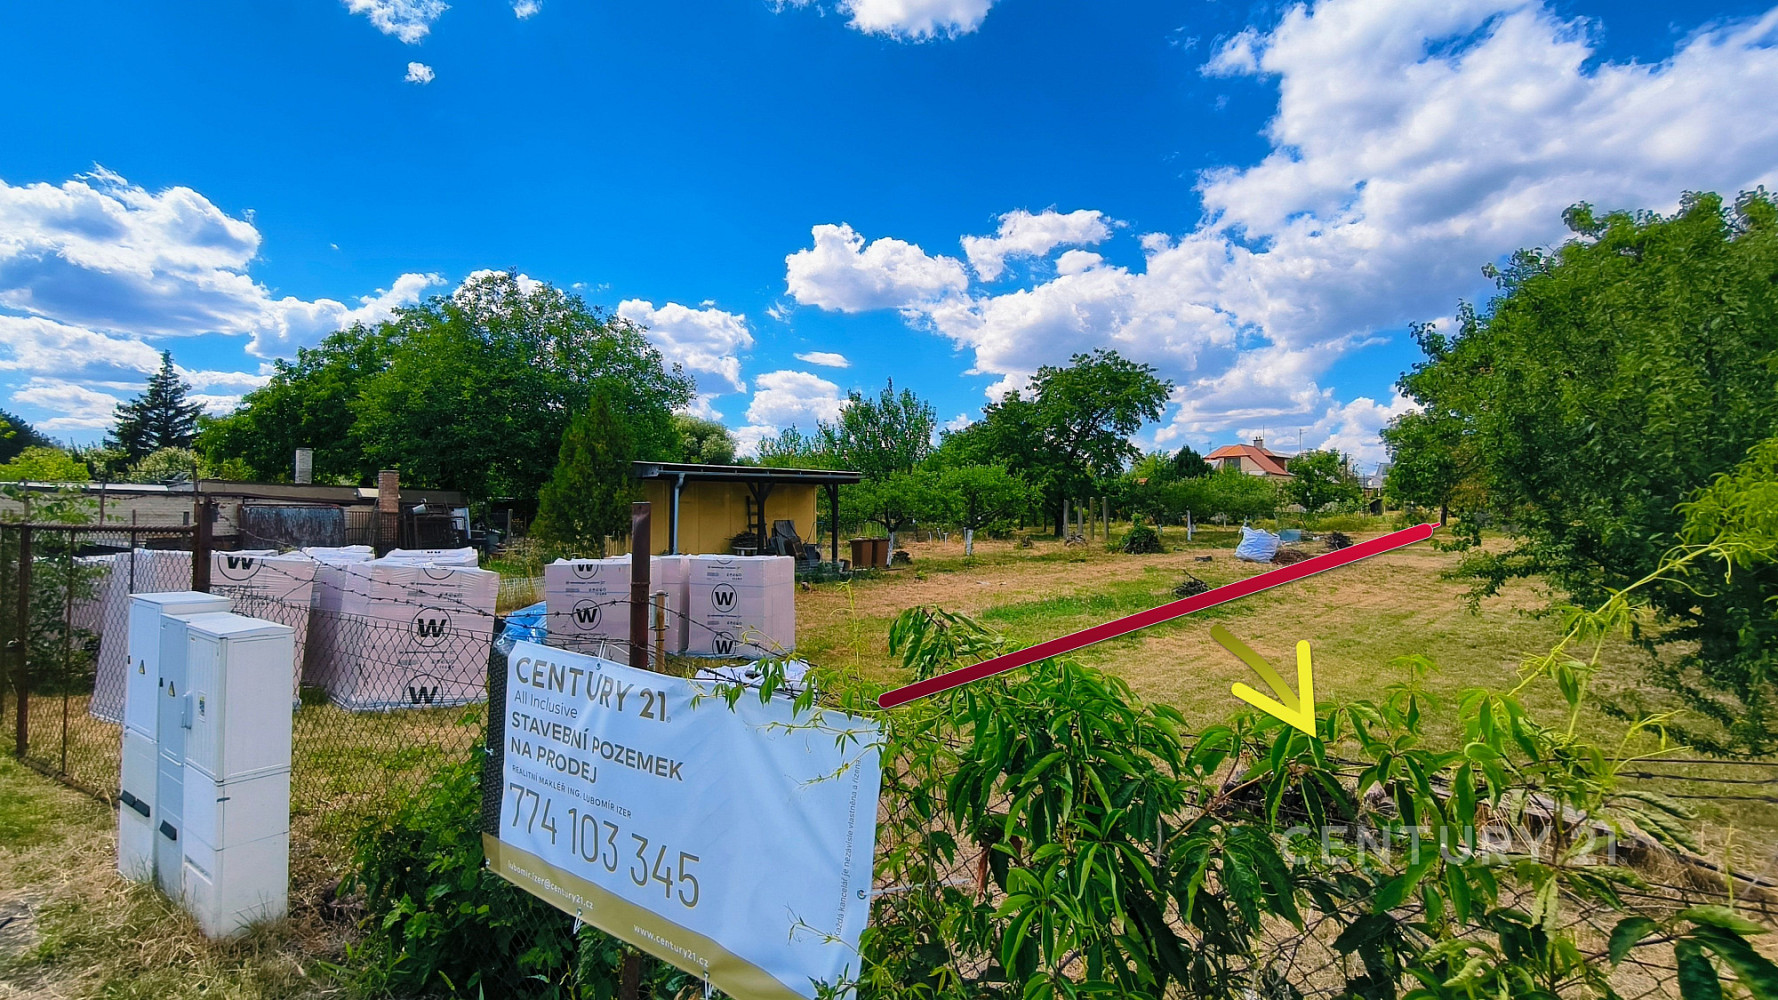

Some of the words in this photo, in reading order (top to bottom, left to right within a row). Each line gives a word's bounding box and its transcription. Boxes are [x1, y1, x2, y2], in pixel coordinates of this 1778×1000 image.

[576, 608, 598, 623] W
[714, 591, 734, 606] W
[417, 618, 447, 638] W
[716, 640, 734, 655] W
[514, 690, 527, 705] All
[530, 693, 578, 719] Inclusive
[516, 656, 634, 712] CENTURY
[510, 737, 532, 759] NA
[536, 746, 598, 784] PRODEJ
[511, 711, 590, 751] STAVEBNÍ
[592, 736, 684, 781] POZEMEK
[512, 764, 538, 782] REALITNÍ
[539, 775, 566, 793] MAKLÉŘ
[567, 786, 582, 798] ING.
[583, 792, 615, 811] LUBOMÍR
[616, 805, 632, 819] IZER
[509, 783, 557, 846] 774
[568, 808, 619, 874] 103
[630, 833, 700, 908] 345
[508, 859, 594, 910] lubomir.izer@century21.cz
[841, 868, 851, 878] je
[633, 924, 709, 969] www.century21.cz
